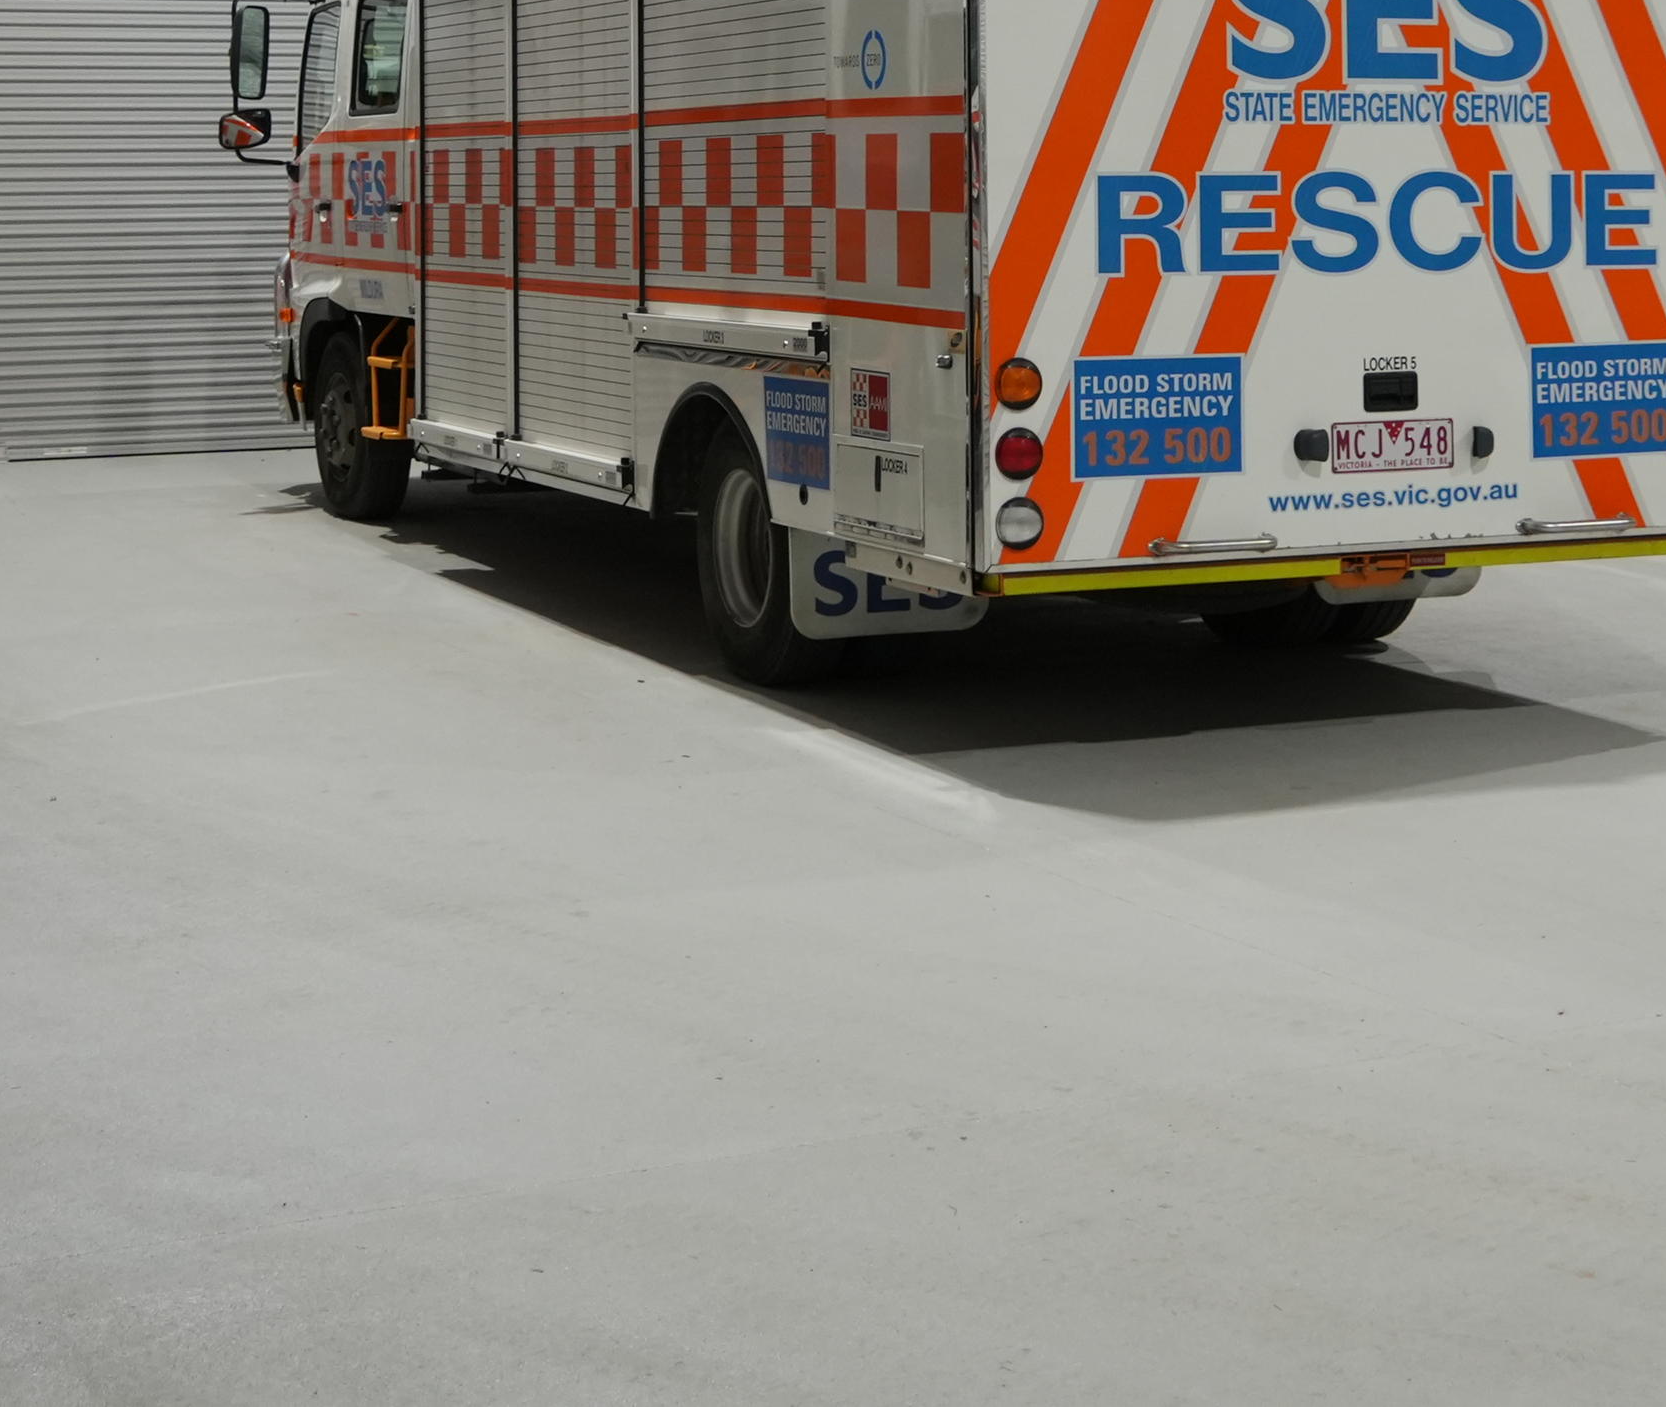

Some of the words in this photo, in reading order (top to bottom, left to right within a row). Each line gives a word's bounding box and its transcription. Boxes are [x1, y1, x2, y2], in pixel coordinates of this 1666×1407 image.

[866, 53, 882, 67] ZERO
[1225, 92, 1293, 123] STATE
[1304, 93, 1445, 123] EMERGENCY
[1456, 94, 1549, 124] SERVICE
[348, 160, 388, 218] SES
[1097, 170, 1659, 274] RESCUE
[1363, 356, 1408, 372] LOCKER
[1410, 356, 1417, 370] 5
[1536, 360, 1597, 380] FLOOD
[1080, 374, 1150, 395] FLOOD
[1156, 372, 1233, 393] STORM
[765, 390, 793, 409] FLOOD
[795, 394, 827, 413] STORM
[853, 393, 867, 407] SES
[1080, 395, 1234, 421] EMERGENCY
[767, 411, 827, 437] EMERGENCY
[1539, 410, 1600, 447] 132
[1083, 428, 1150, 467] 132
[1163, 426, 1232, 464] 500
[1336, 428, 1383, 460] MCJ
[1404, 426, 1448, 456] 548
[1337, 461, 1373, 470] VICTORIA
[1400, 459, 1423, 467] PLACE
[1426, 458, 1436, 466] TO
[1269, 483, 1519, 512] www.ses.vic.gov.au
